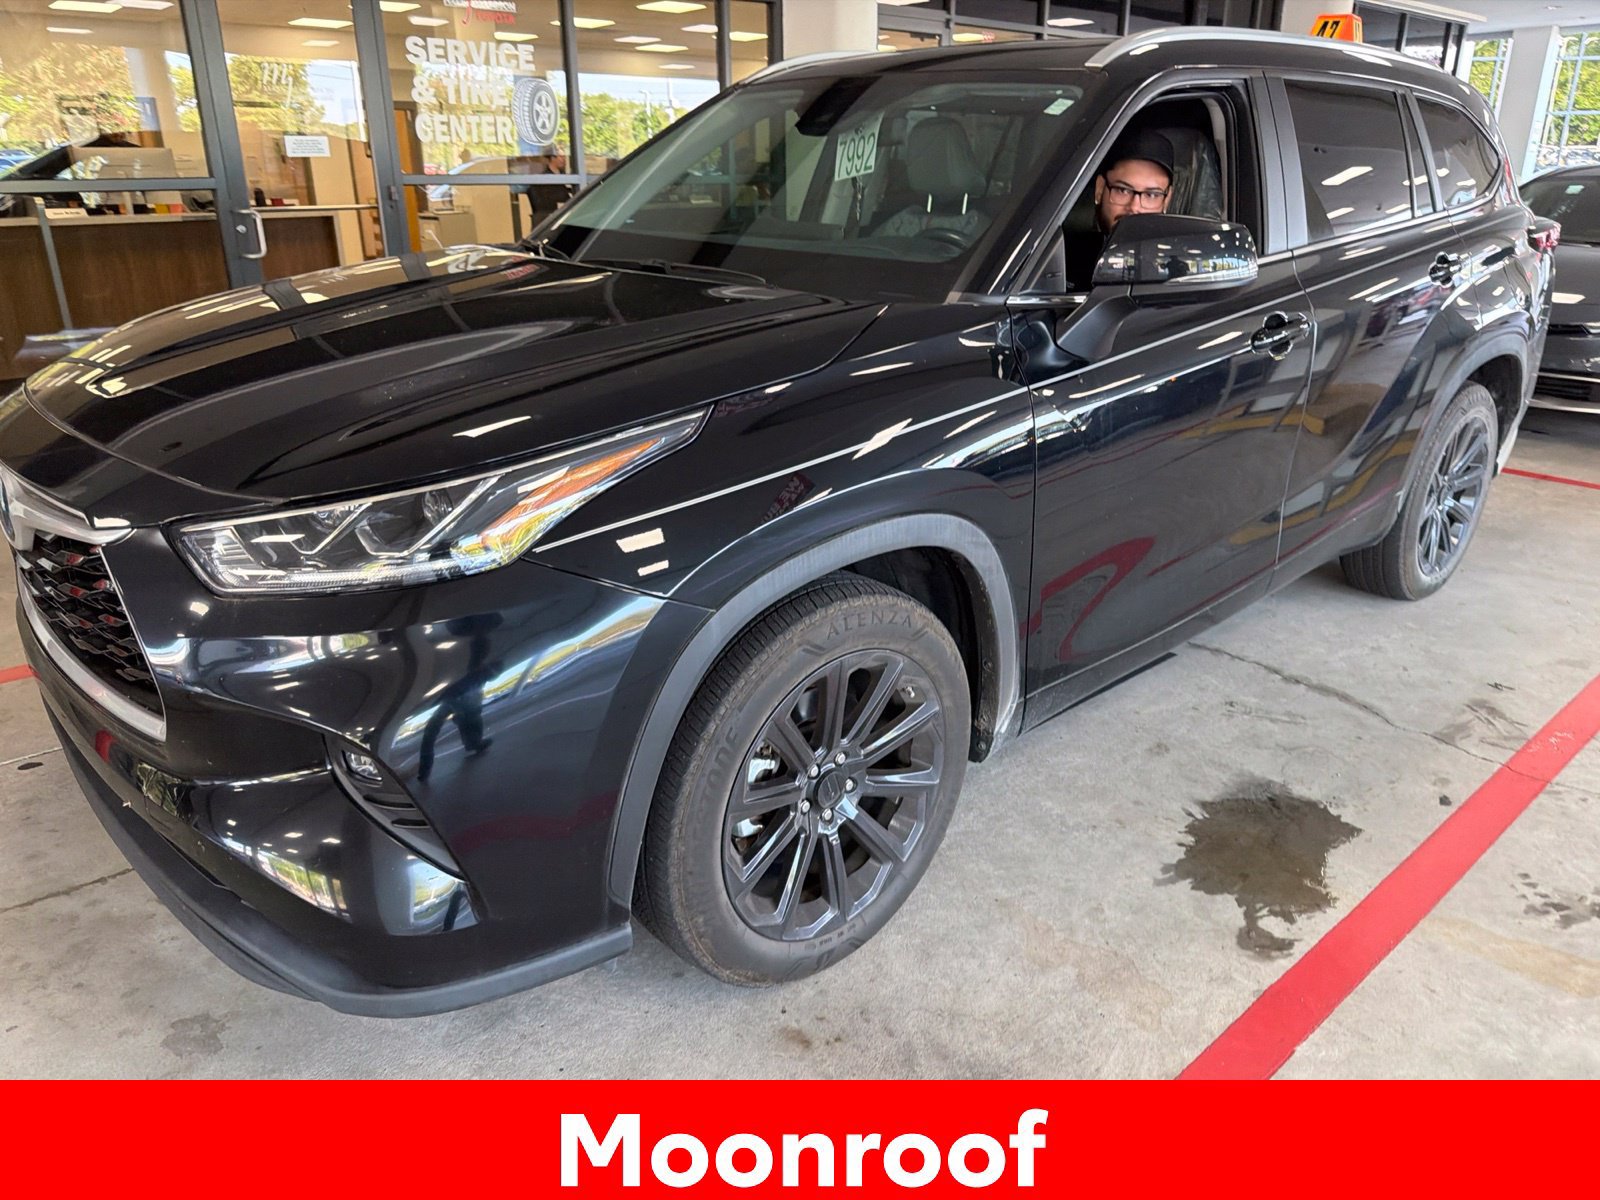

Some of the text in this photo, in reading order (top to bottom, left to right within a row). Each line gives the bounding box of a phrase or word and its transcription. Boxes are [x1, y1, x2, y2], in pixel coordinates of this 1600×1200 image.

[405, 35, 536, 71] SERVICE
[411, 75, 510, 107] & TIRE
[415, 112, 513, 145] CENTER
[838, 132, 876, 179] 7992
[826, 610, 912, 640] ALENZA
